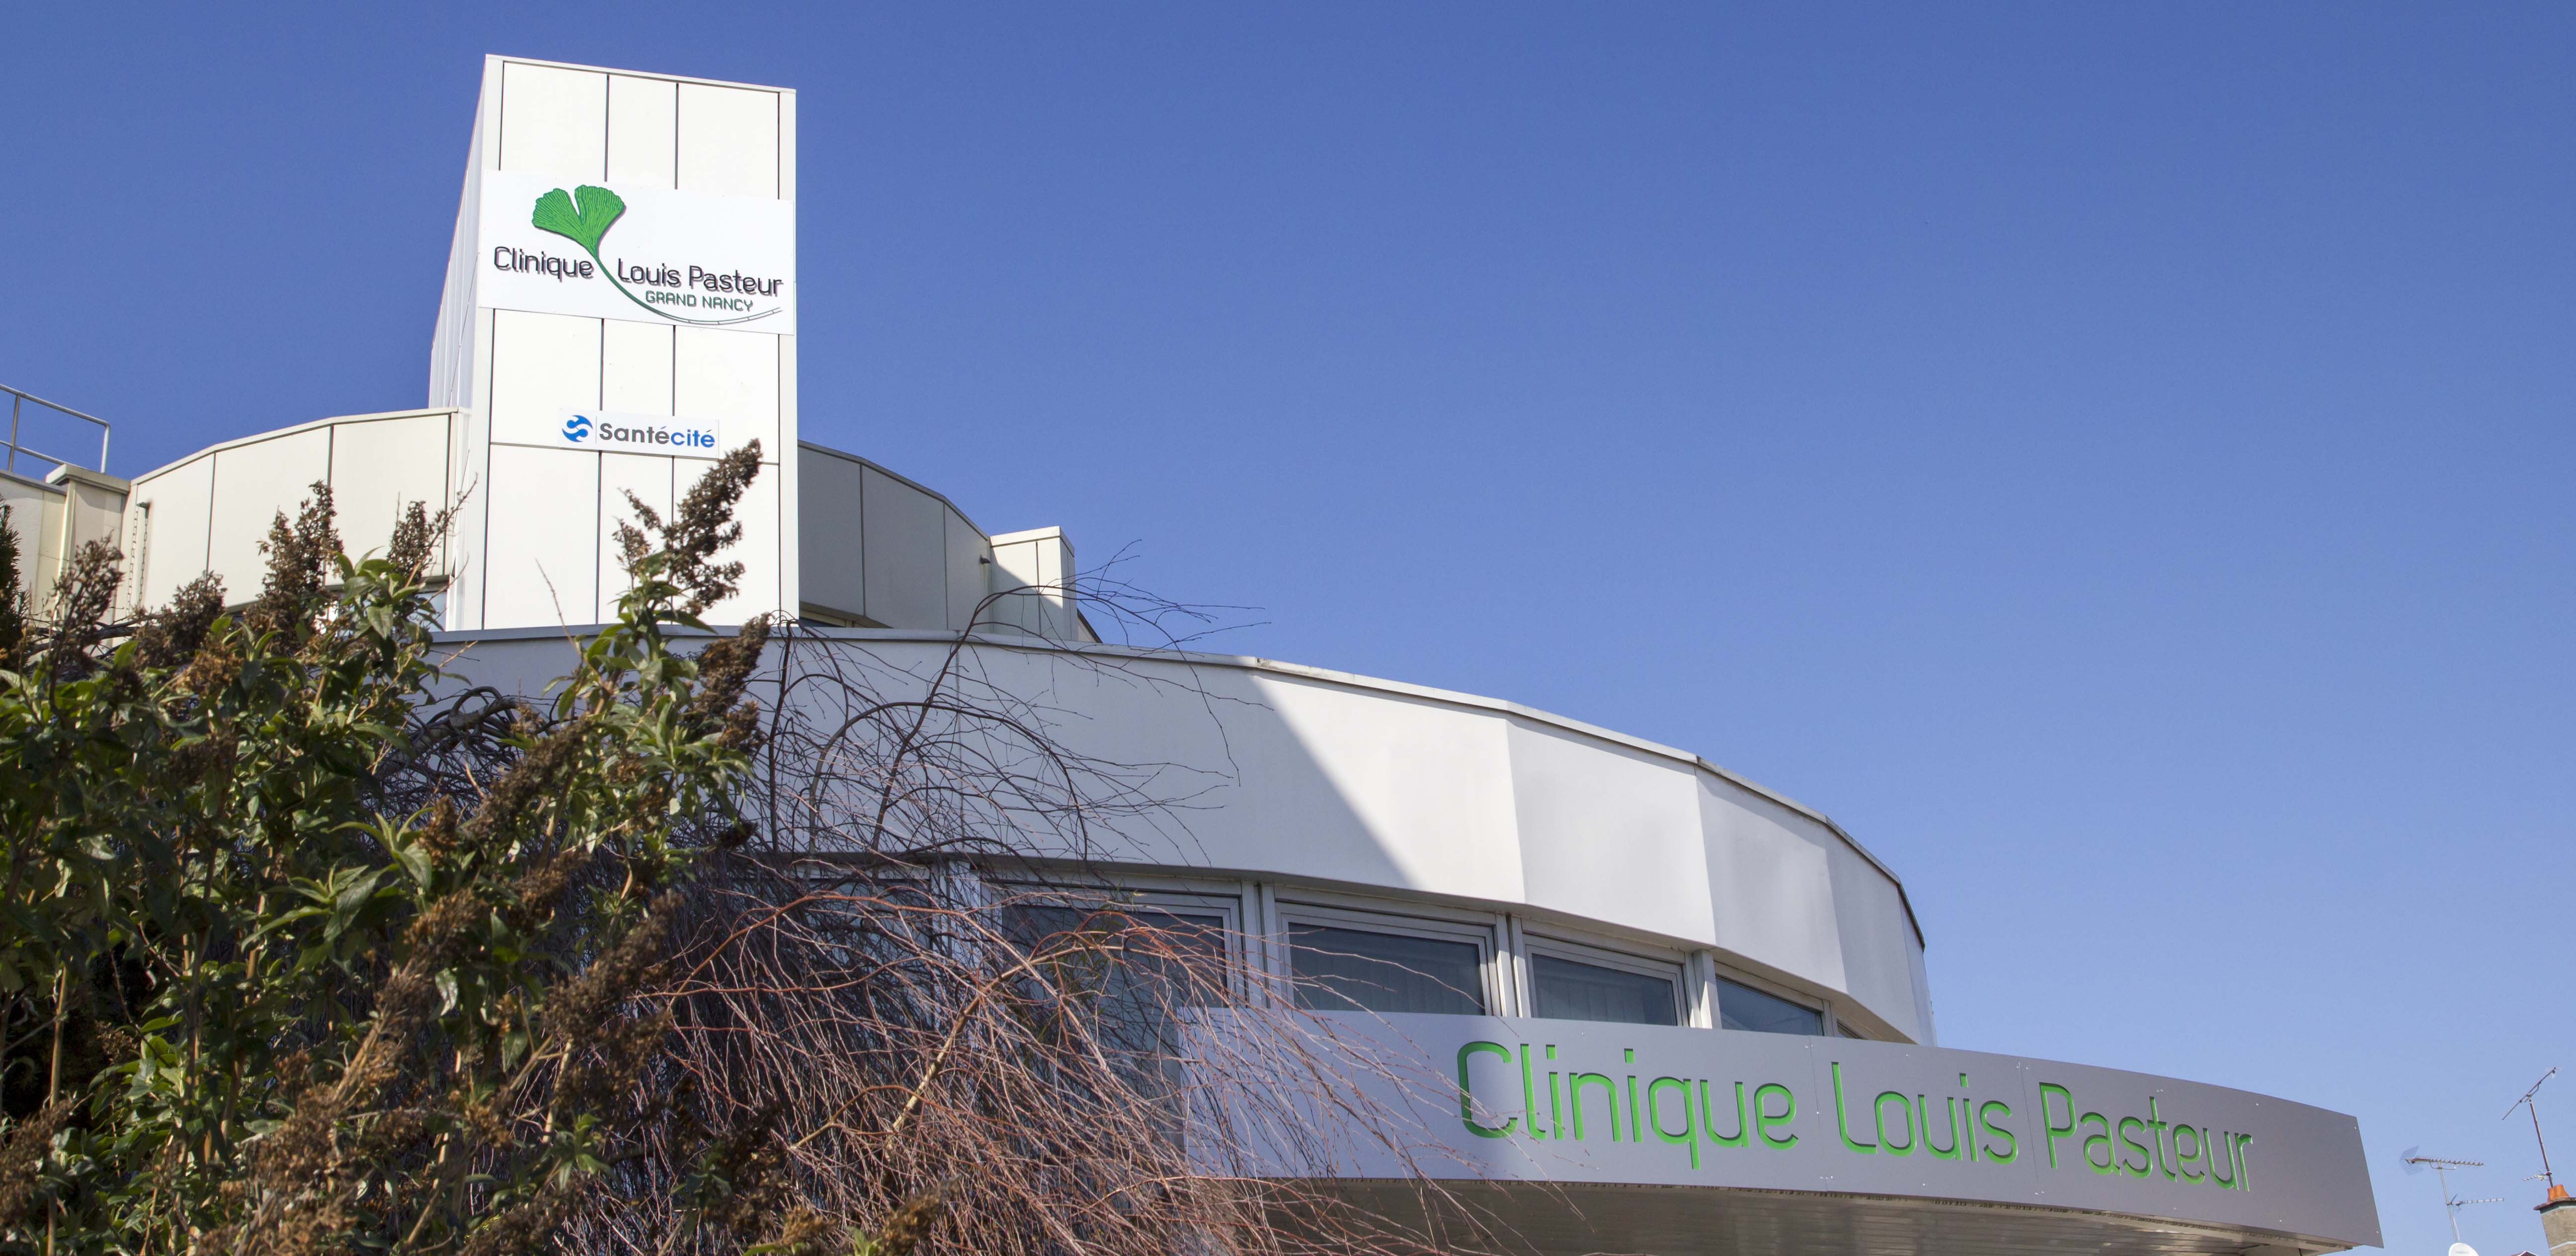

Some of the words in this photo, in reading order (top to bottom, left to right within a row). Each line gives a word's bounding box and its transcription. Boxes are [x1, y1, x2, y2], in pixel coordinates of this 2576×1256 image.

[494, 246, 593, 281] Clinique
[617, 258, 680, 287] Louis
[688, 265, 783, 296] Pasteur
[645, 291, 697, 307] GRAND
[702, 296, 753, 312] NANCY
[599, 423, 715, 448] Santécité
[1457, 1041, 1799, 1170] Clinique
[1831, 1061, 2018, 1164] Louis
[2039, 1082, 2253, 1192] Pasteur
